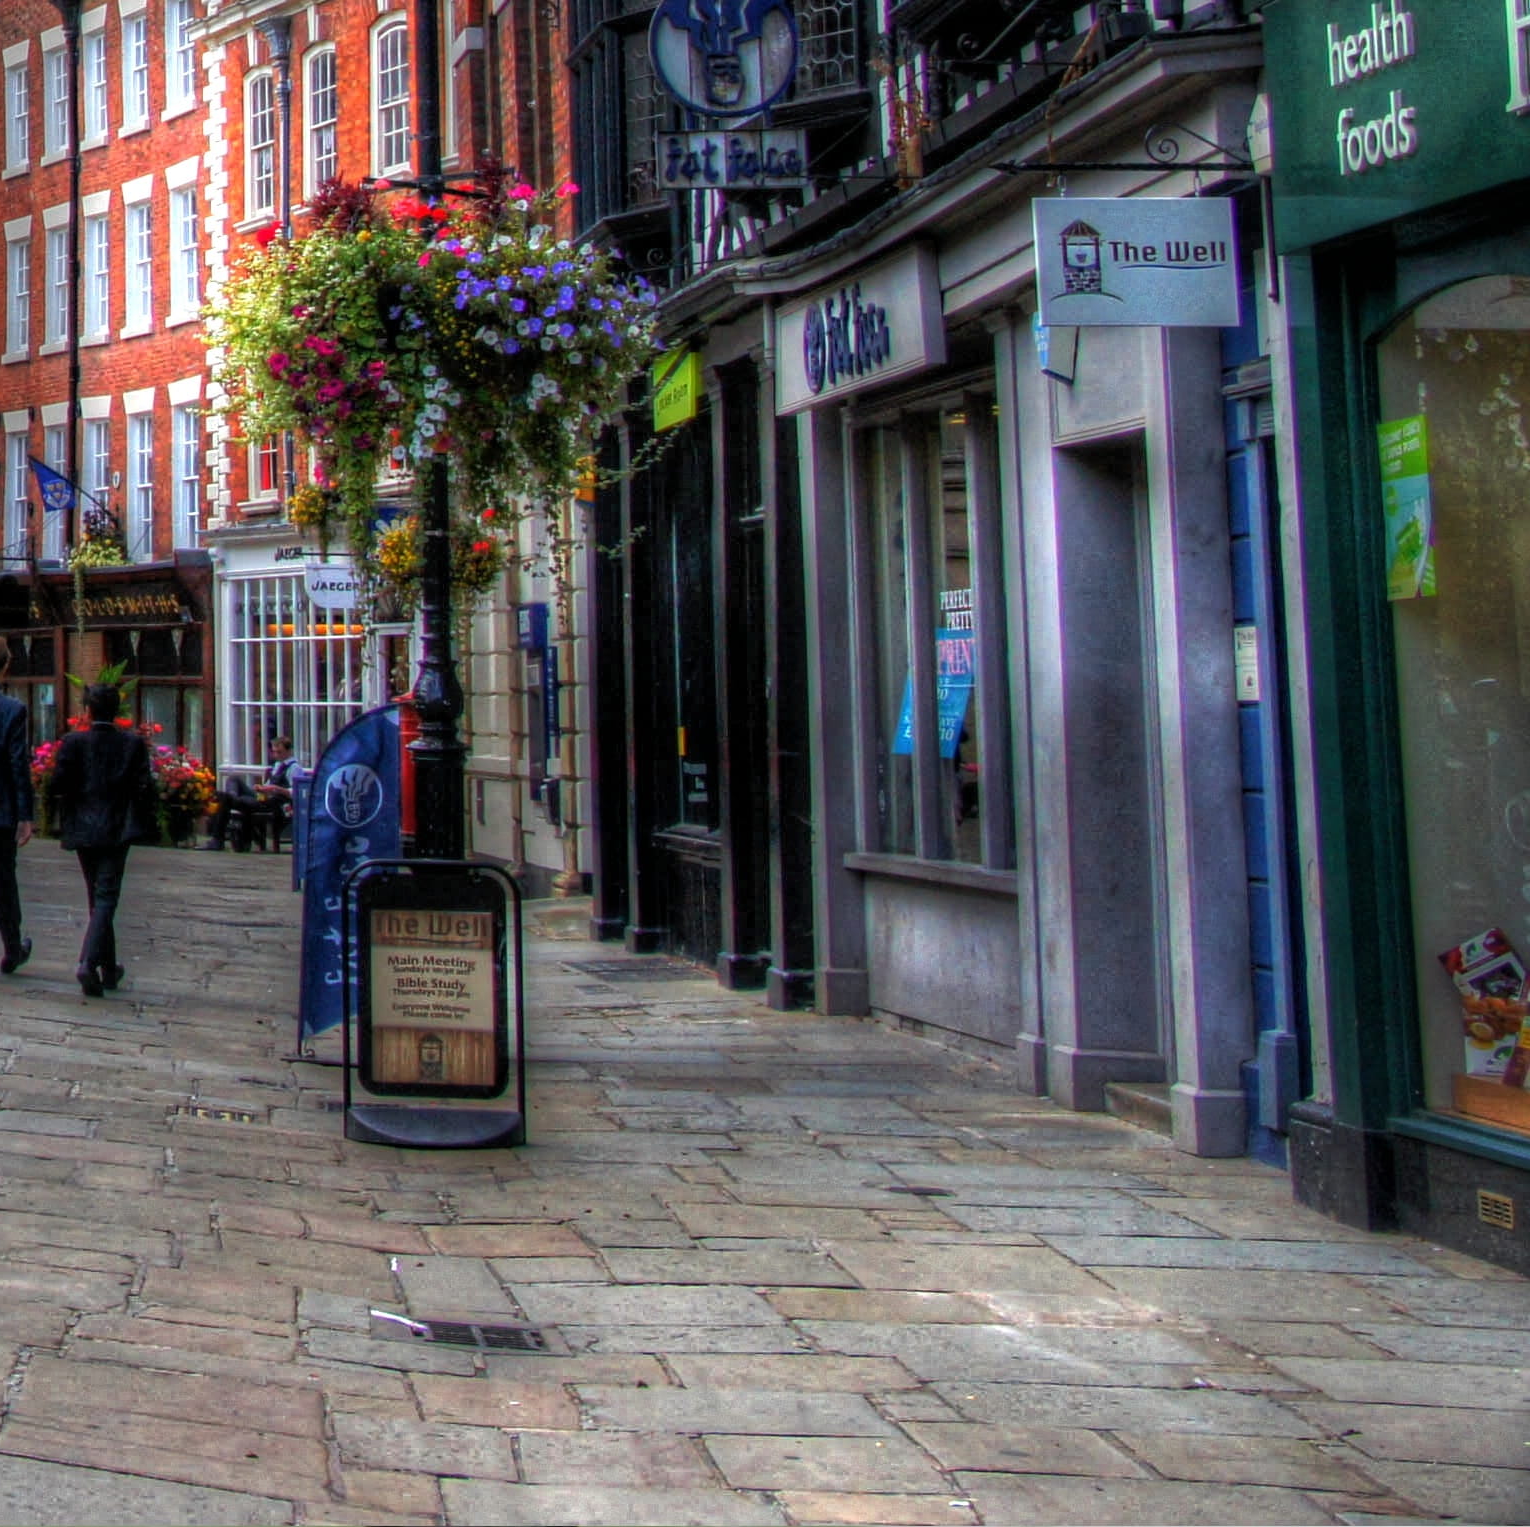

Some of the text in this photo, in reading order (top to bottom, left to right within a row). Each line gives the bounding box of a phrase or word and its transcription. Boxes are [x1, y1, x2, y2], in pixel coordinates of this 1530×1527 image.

[1337, 90, 1419, 176] foods
[1108, 240, 1226, 262] The Well
[375, 913, 487, 936] The Well
[388, 955, 476, 971] Main Meeting
[397, 978, 467, 992] Bible Study
